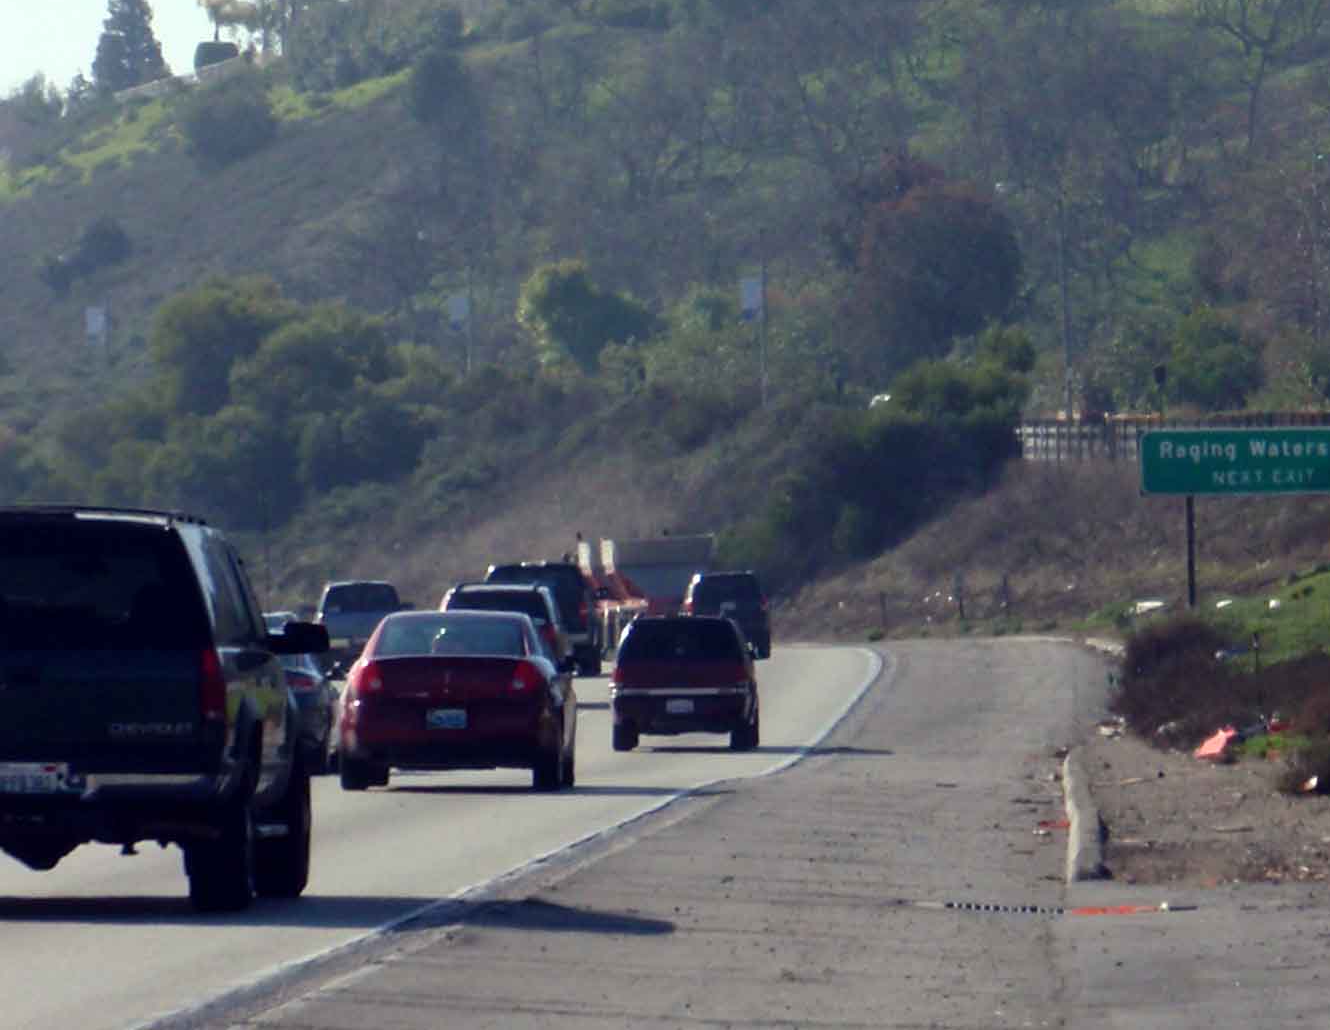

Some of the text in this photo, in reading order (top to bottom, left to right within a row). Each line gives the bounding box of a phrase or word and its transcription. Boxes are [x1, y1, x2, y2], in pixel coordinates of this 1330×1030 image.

[1159, 441, 1237, 464] Raging
[1249, 438, 1329, 459] Waters
[1212, 469, 1316, 486] NEXT EXIT
